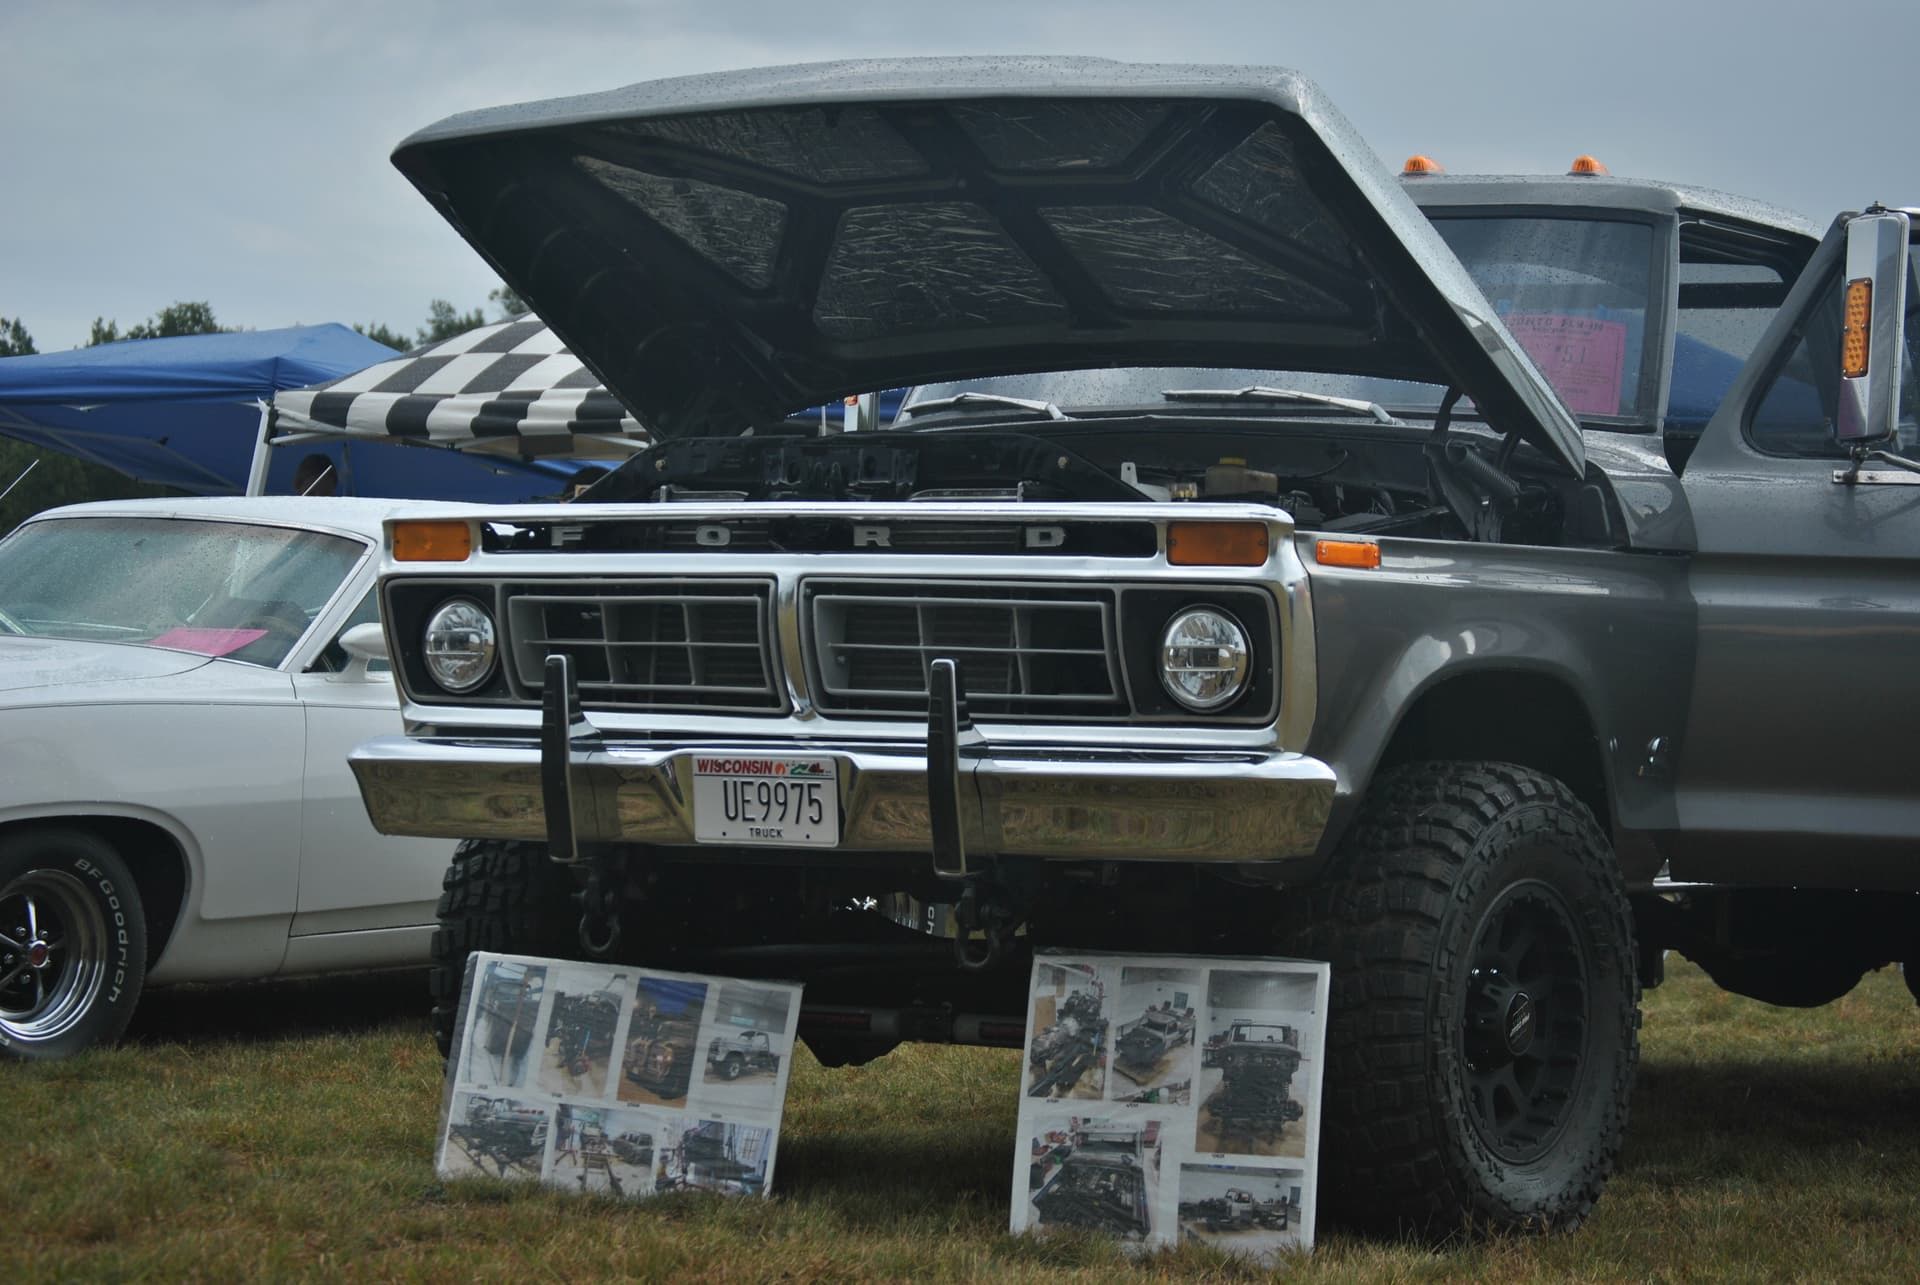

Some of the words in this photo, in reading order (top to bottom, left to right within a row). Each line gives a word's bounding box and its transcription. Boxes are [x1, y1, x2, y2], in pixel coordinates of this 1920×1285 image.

[550, 524, 1066, 548] FORD
[697, 759, 773, 774] WISCONSIN
[722, 780, 823, 825] UE9975
[748, 827, 783, 838] TRUCK
